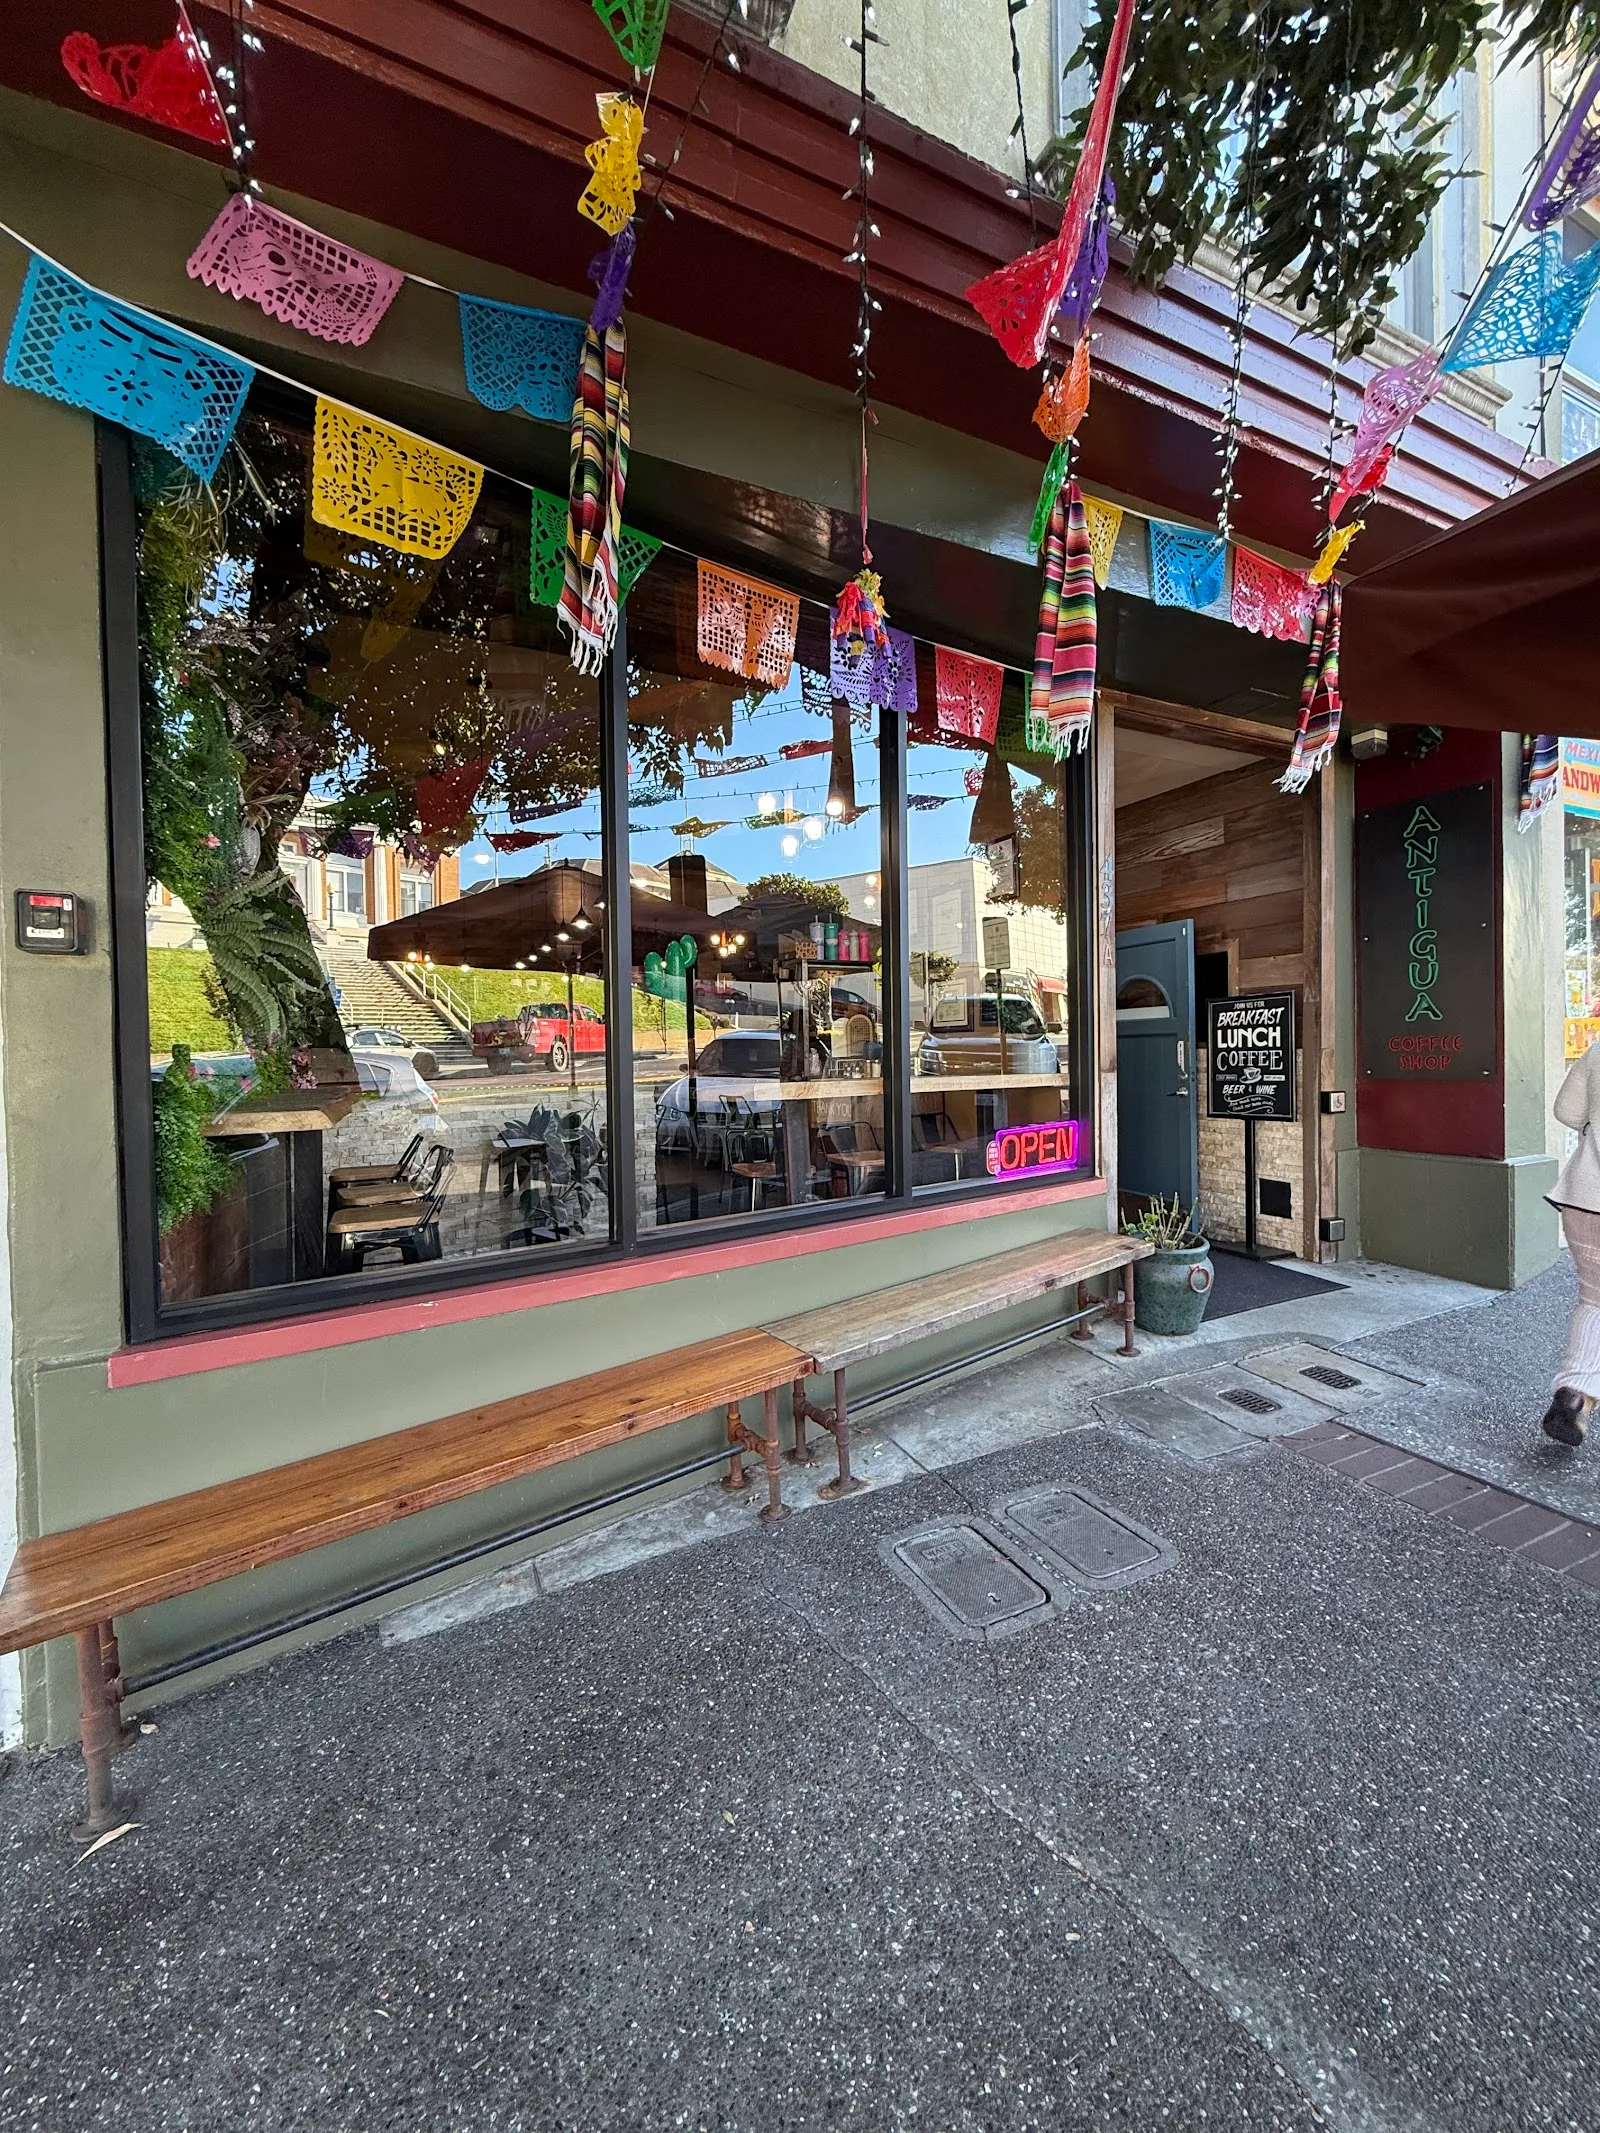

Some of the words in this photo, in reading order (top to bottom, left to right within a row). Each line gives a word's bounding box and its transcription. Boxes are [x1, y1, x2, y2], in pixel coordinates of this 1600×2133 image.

[1403, 805, 1443, 1022] ANTIGUA
[1233, 1001, 1245, 1010] JOIN
[1246, 1001, 1253, 1009] US
[1254, 1000, 1265, 1008] FOR
[1217, 1007, 1285, 1027] BREAKFAST
[1217, 1026, 1281, 1049] LUNCH
[1389, 1035, 1463, 1052] COFFEE
[1216, 1050, 1284, 1071] COFFEE
[1399, 1054, 1451, 1071] SHOP
[1222, 1084, 1246, 1095] BEER
[1256, 1084, 1277, 1095] WINE
[812, 1100, 835, 1116] THANK
[835, 1102, 852, 1117] YOU
[1000, 1126, 1074, 1170] OPEN
